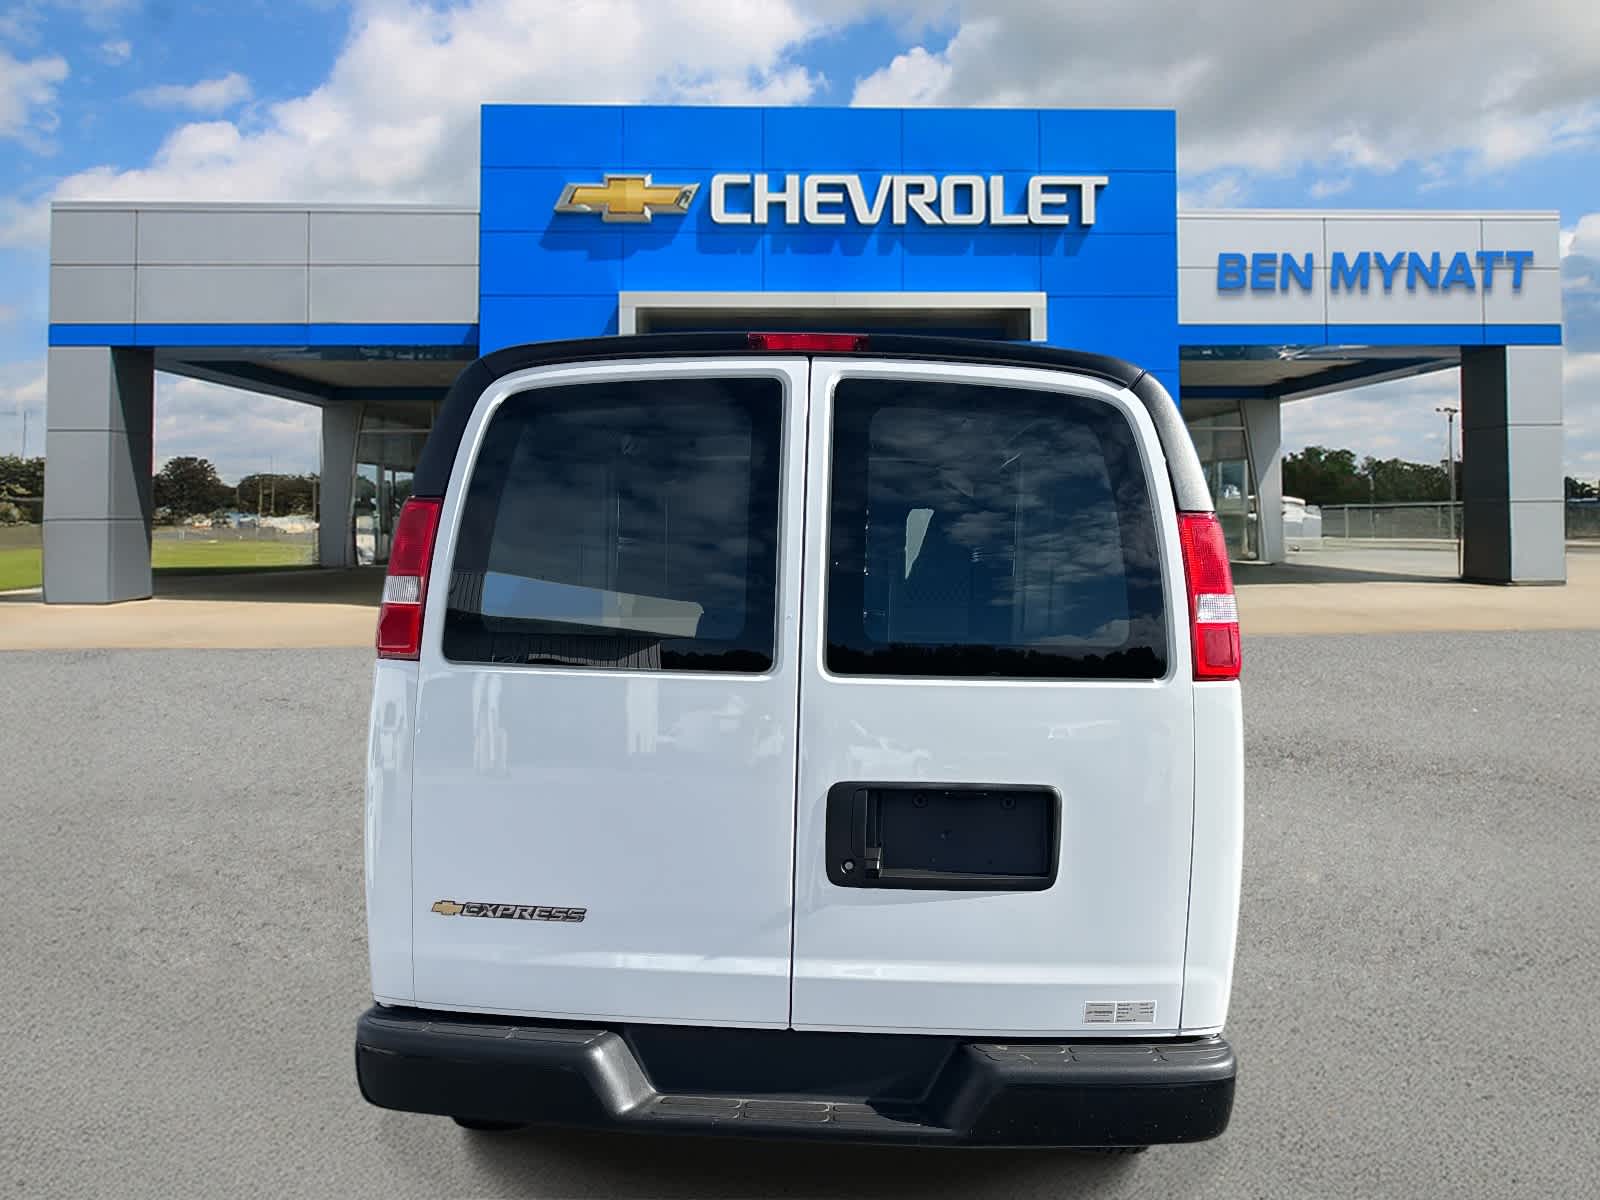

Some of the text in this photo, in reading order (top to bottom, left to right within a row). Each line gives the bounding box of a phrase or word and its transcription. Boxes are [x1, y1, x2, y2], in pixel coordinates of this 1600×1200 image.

[710, 174, 1109, 225] CHEVROLET
[1217, 250, 1534, 291] BEN MYNATT
[462, 902, 588, 922] EXPRESS
